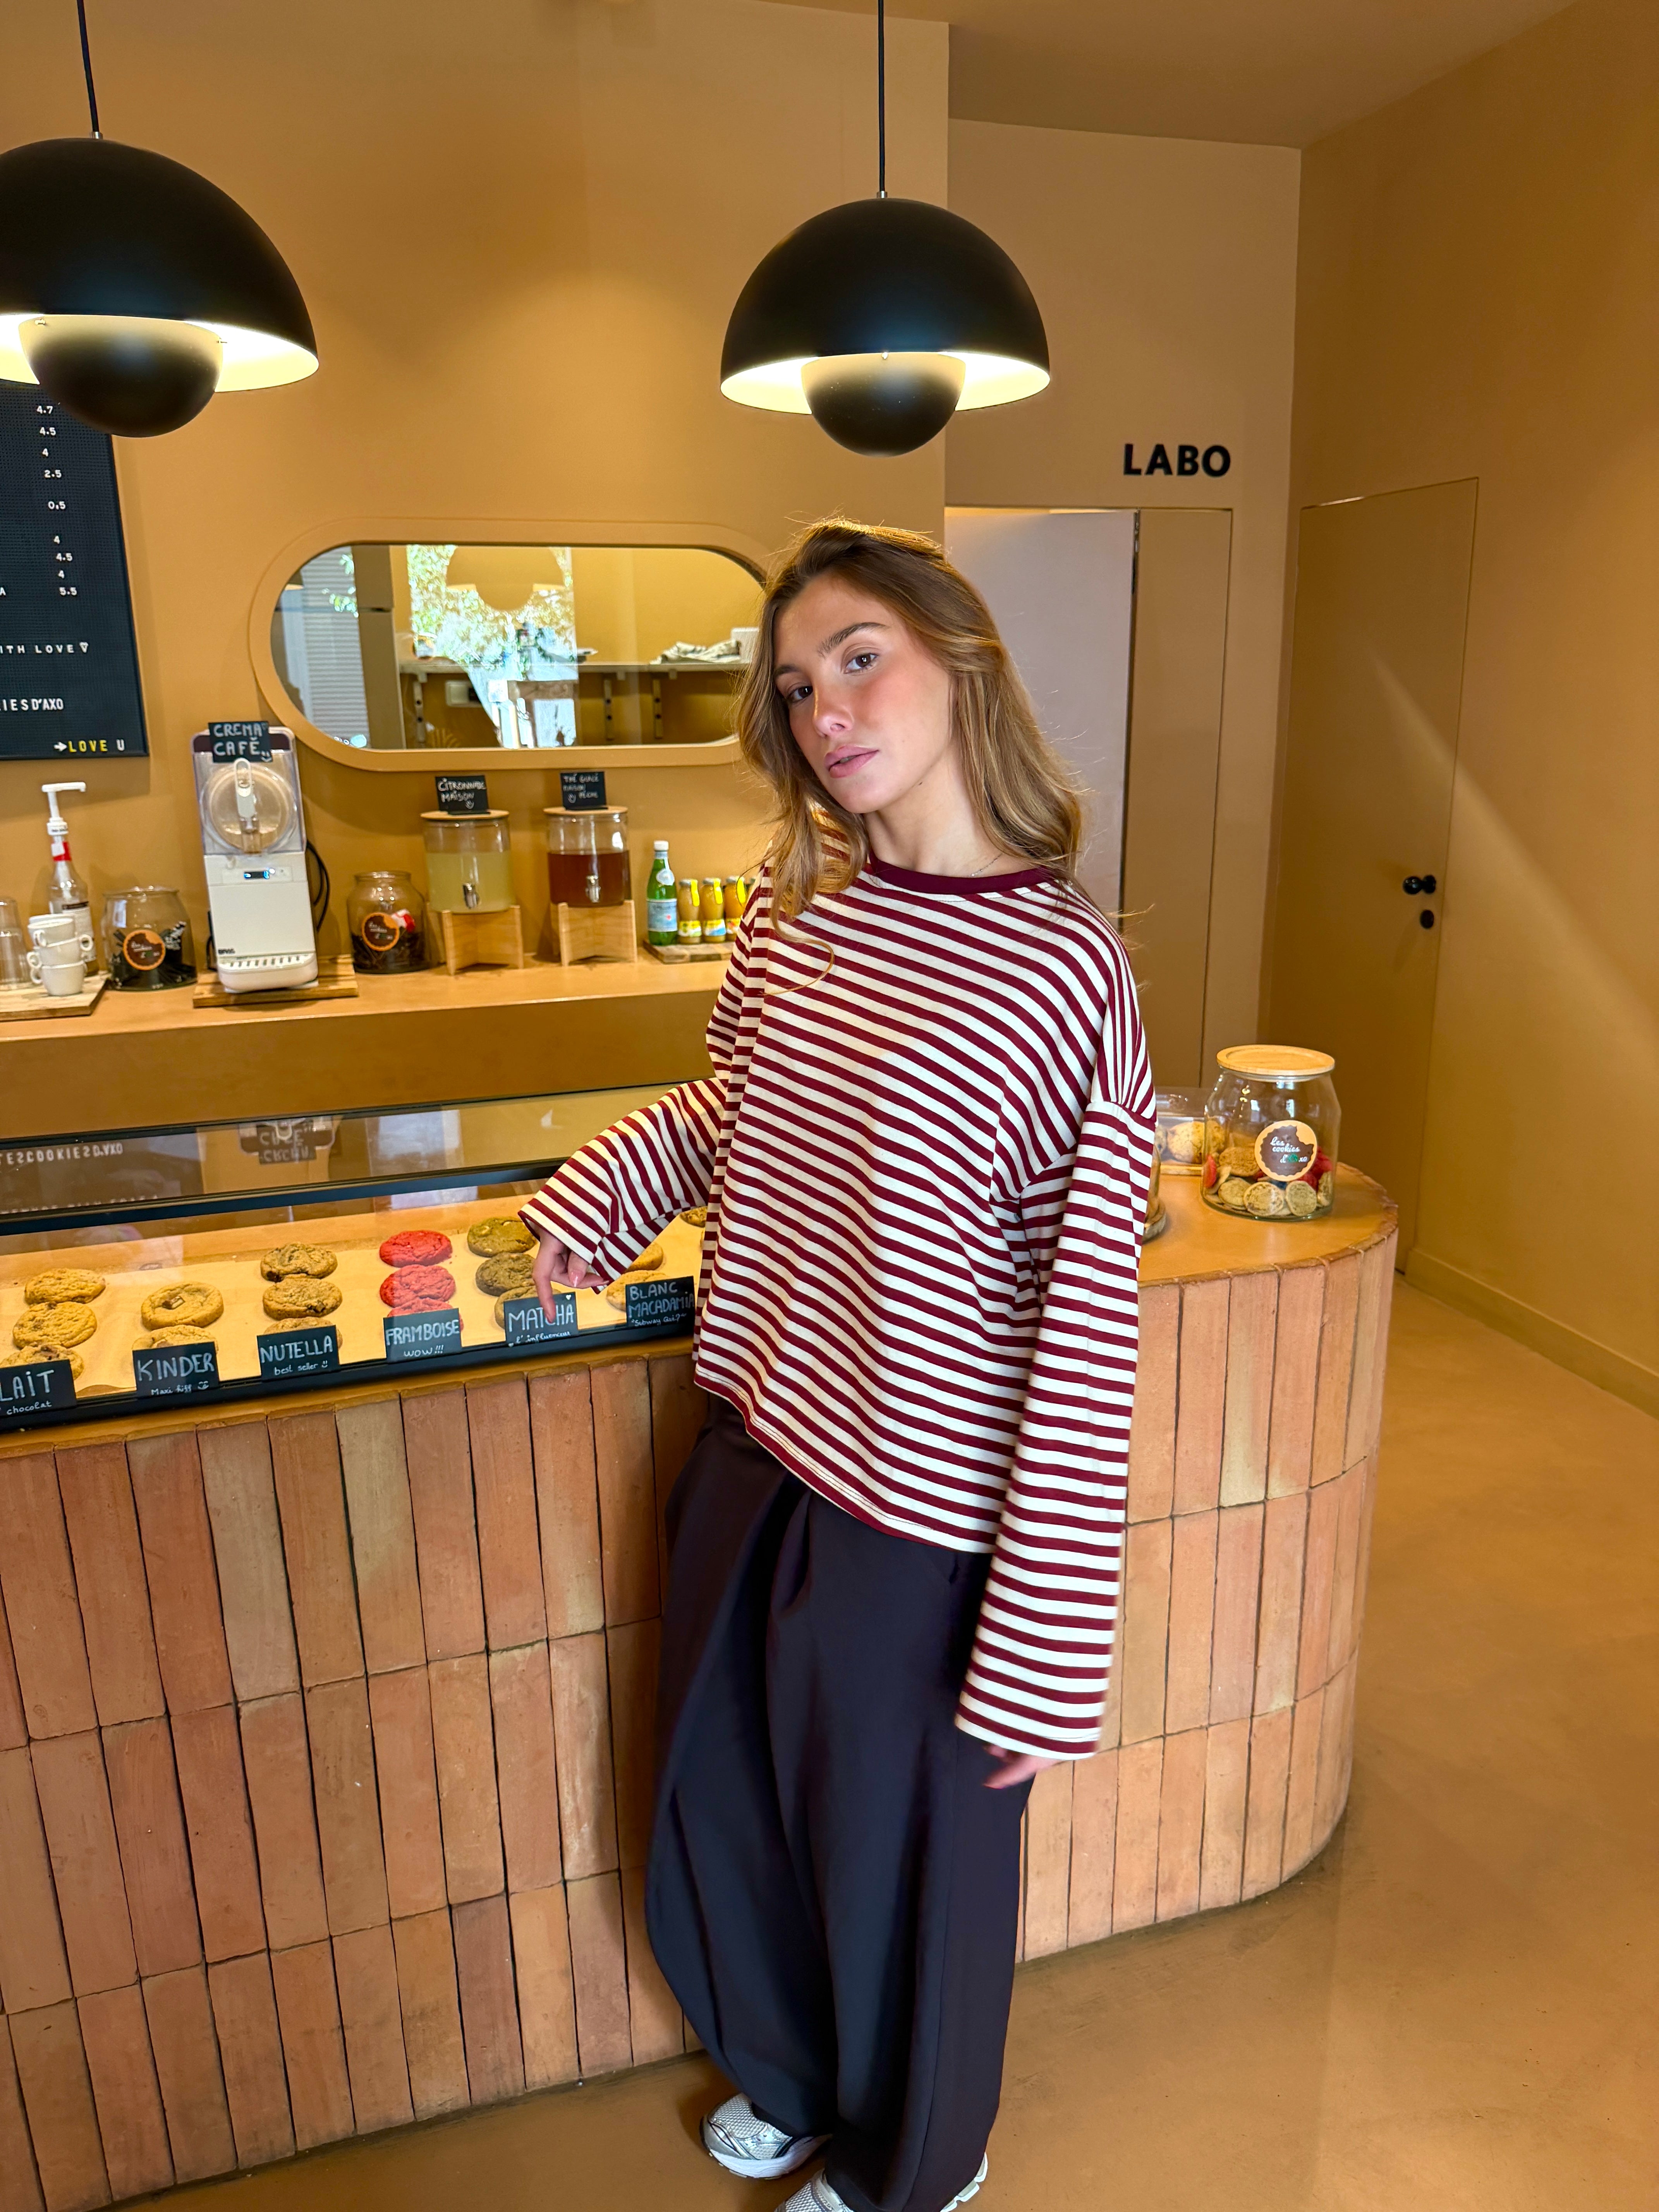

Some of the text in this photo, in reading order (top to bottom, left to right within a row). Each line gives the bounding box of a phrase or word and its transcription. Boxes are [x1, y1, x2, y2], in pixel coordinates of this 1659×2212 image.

[36, 405, 53, 414] 4.7
[40, 427, 56, 436] 4.5
[42, 448, 49, 457] 4
[1123, 443, 1231, 478] LABO
[44, 469, 62, 478] 2.5
[53, 535, 60, 544] 4
[56, 553, 73, 562] 4.5
[58, 570, 65, 579] 4
[59, 587, 77, 596] 5.5
[35, 644, 74, 654] LOVE
[0, 698, 64, 711] IESD'AXO
[213, 723, 263, 737] CREMA
[68, 739, 125, 752] LOVE U
[1272, 1143, 1300, 1152] cookies
[629, 1281, 678, 1301] BLANC
[628, 1291, 695, 1318] MACADAMIA
[385, 1319, 460, 1346] FRAMBOISE
[259, 1335, 333, 1363] NUTELLA
[137, 1352, 215, 1381] KINDER
[274, 1362, 319, 1376] best seller
[7, 1400, 52, 1415] chocolat
